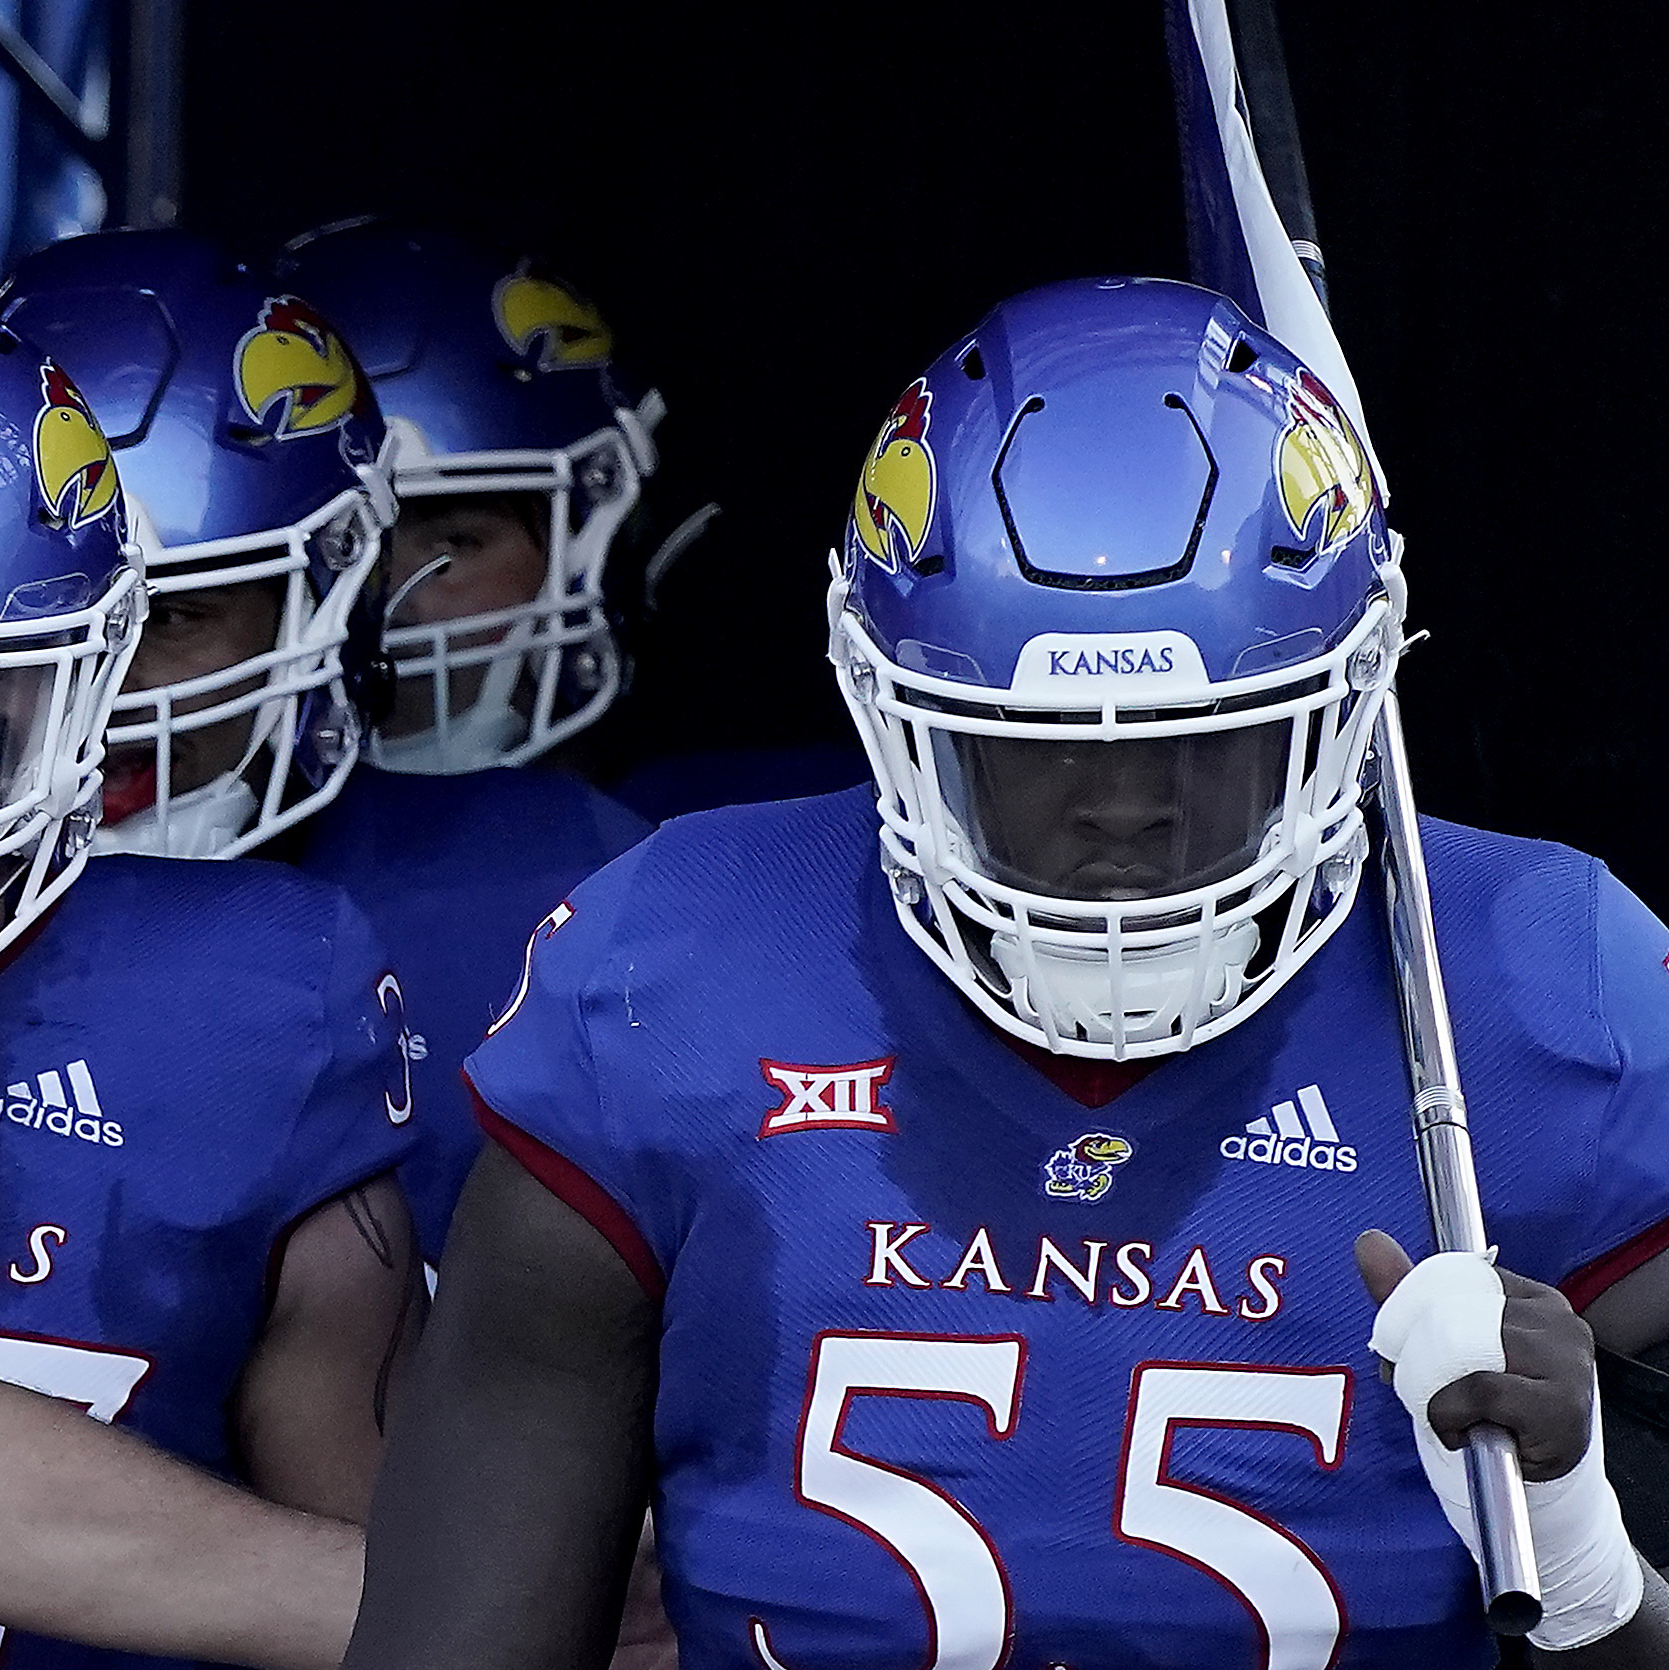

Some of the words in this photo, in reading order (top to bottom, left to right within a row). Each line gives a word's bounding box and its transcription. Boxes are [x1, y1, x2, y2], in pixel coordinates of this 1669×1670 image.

[1047, 647, 1174, 677] KANSAS
[1219, 1133, 1359, 1172] adidas
[865, 1222, 1286, 1321] KANSAS
